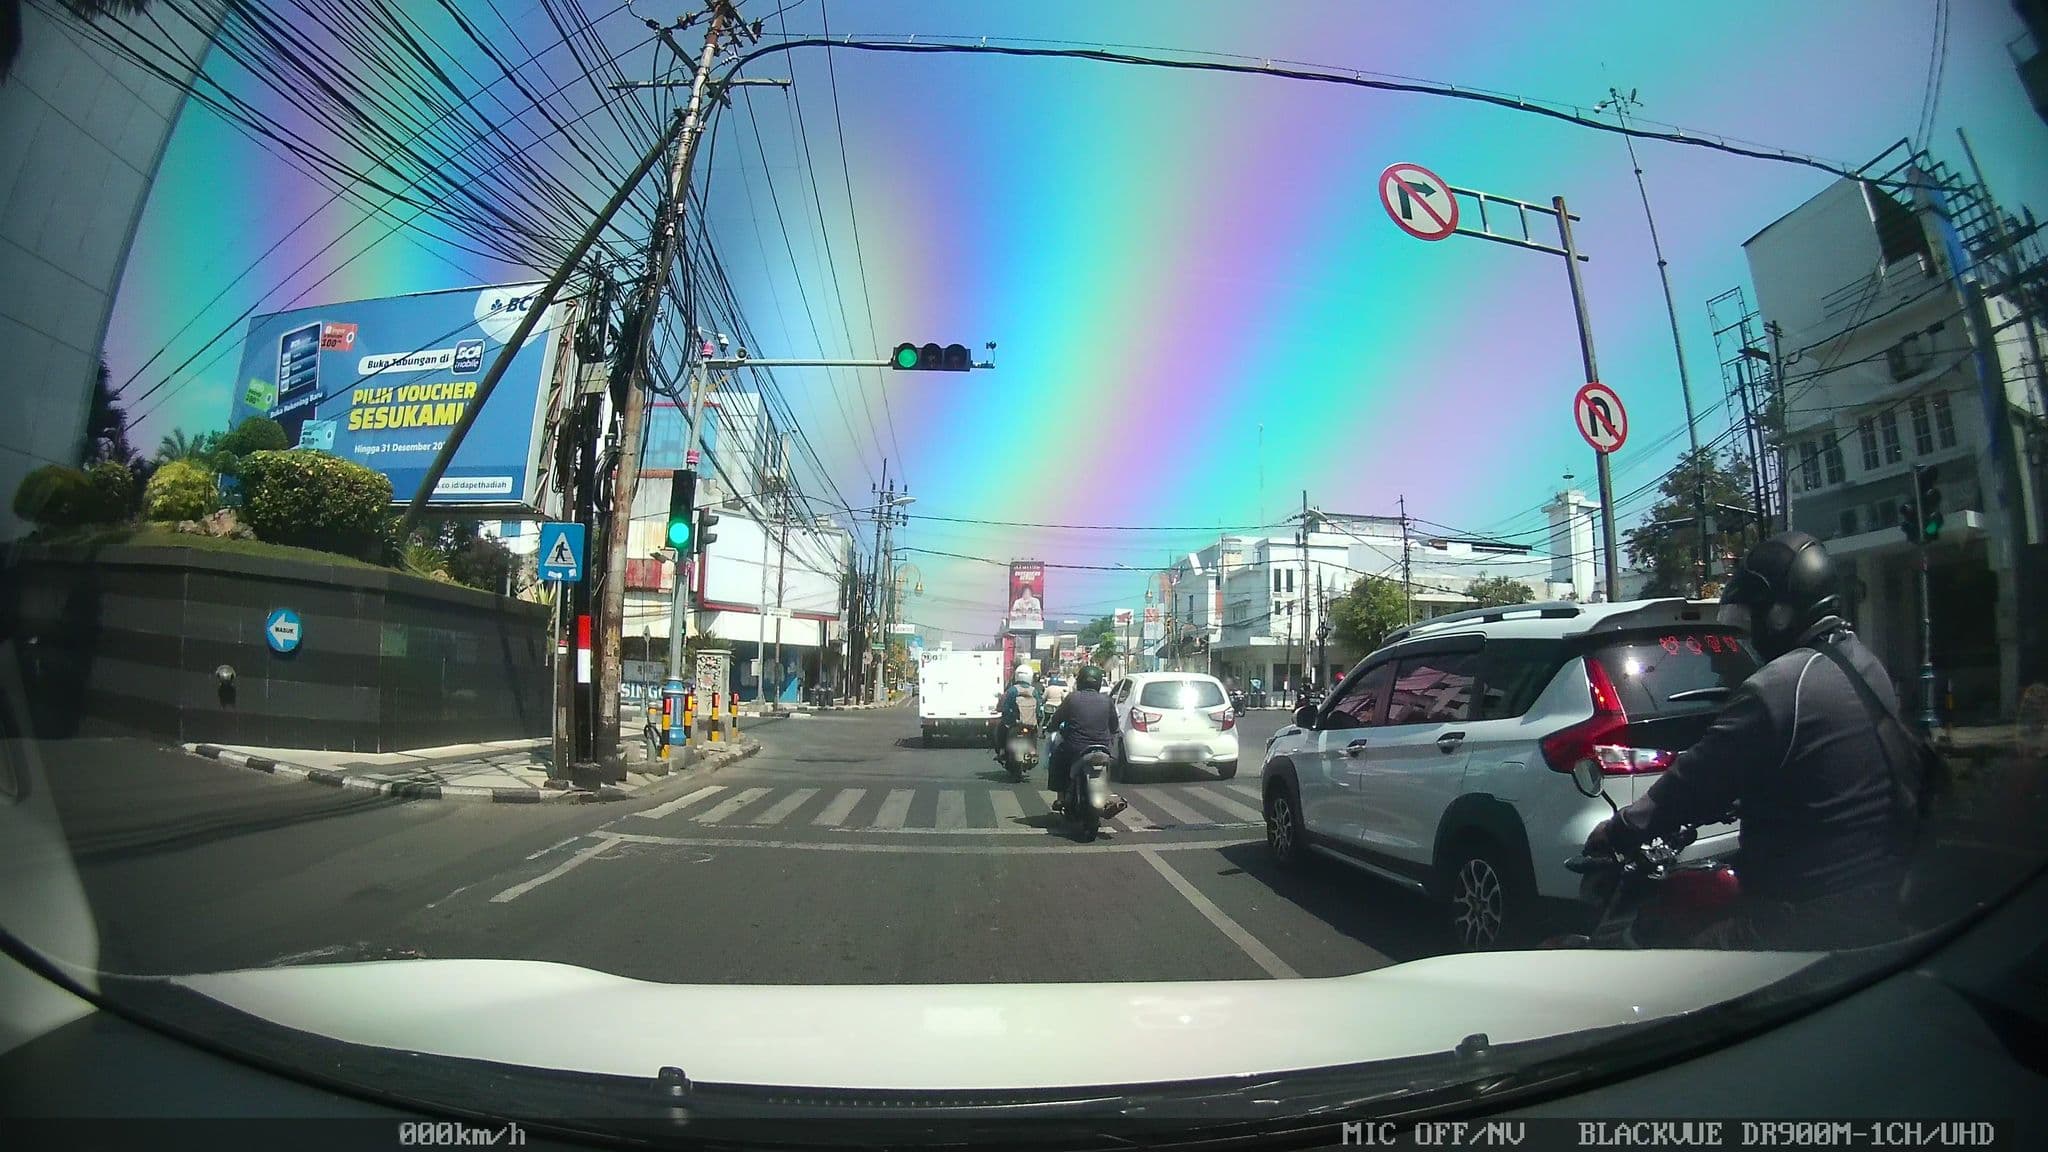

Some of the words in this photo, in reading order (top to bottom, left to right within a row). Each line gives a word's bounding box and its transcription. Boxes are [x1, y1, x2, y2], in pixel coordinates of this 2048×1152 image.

[506, 295, 538, 312] BC
[457, 345, 483, 360] BCA
[367, 360, 389, 369] Buka
[391, 356, 437, 368] Tabungan
[439, 353, 450, 363] di
[455, 359, 480, 369] mobile
[351, 387, 394, 405] PILIH
[397, 382, 478, 402] VOUCHER
[354, 444, 380, 455] Hingga
[381, 444, 390, 452] 31
[392, 442, 431, 452] Desember
